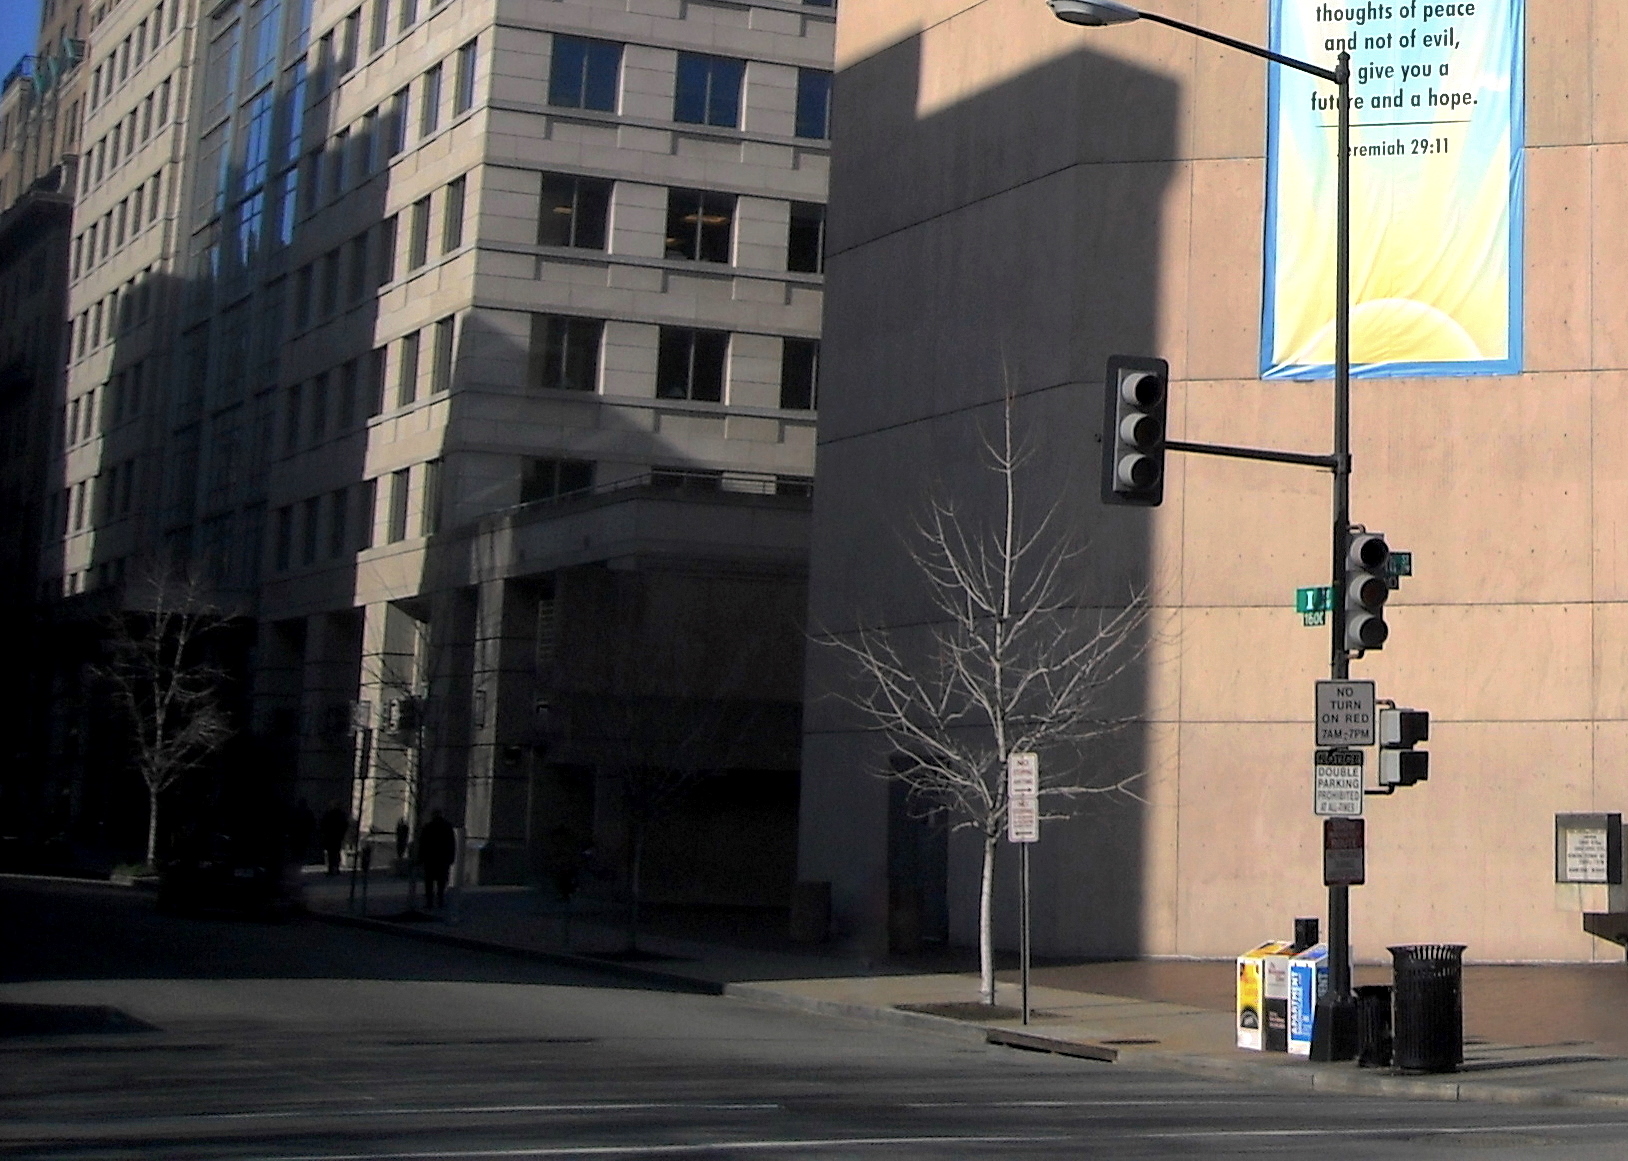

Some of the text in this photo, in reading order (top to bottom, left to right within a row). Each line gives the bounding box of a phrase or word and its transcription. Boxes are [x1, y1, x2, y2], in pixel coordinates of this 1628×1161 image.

[1316, 0, 1475, 25] thoughts of peace
[1324, 26, 1460, 51] and not of evil,
[1358, 61, 1448, 84] give you a
[1371, 88, 1403, 108] and
[1411, 94, 1421, 107] a
[1428, 87, 1478, 110] hope.
[1411, 138, 1448, 154] 29:11
[1337, 687, 1353, 697] NO
[1330, 700, 1361, 710] TURN
[1322, 714, 1369, 723] ON RED
[1318, 767, 1359, 778] DOUBLE
[1317, 778, 1359, 789] PARKING
